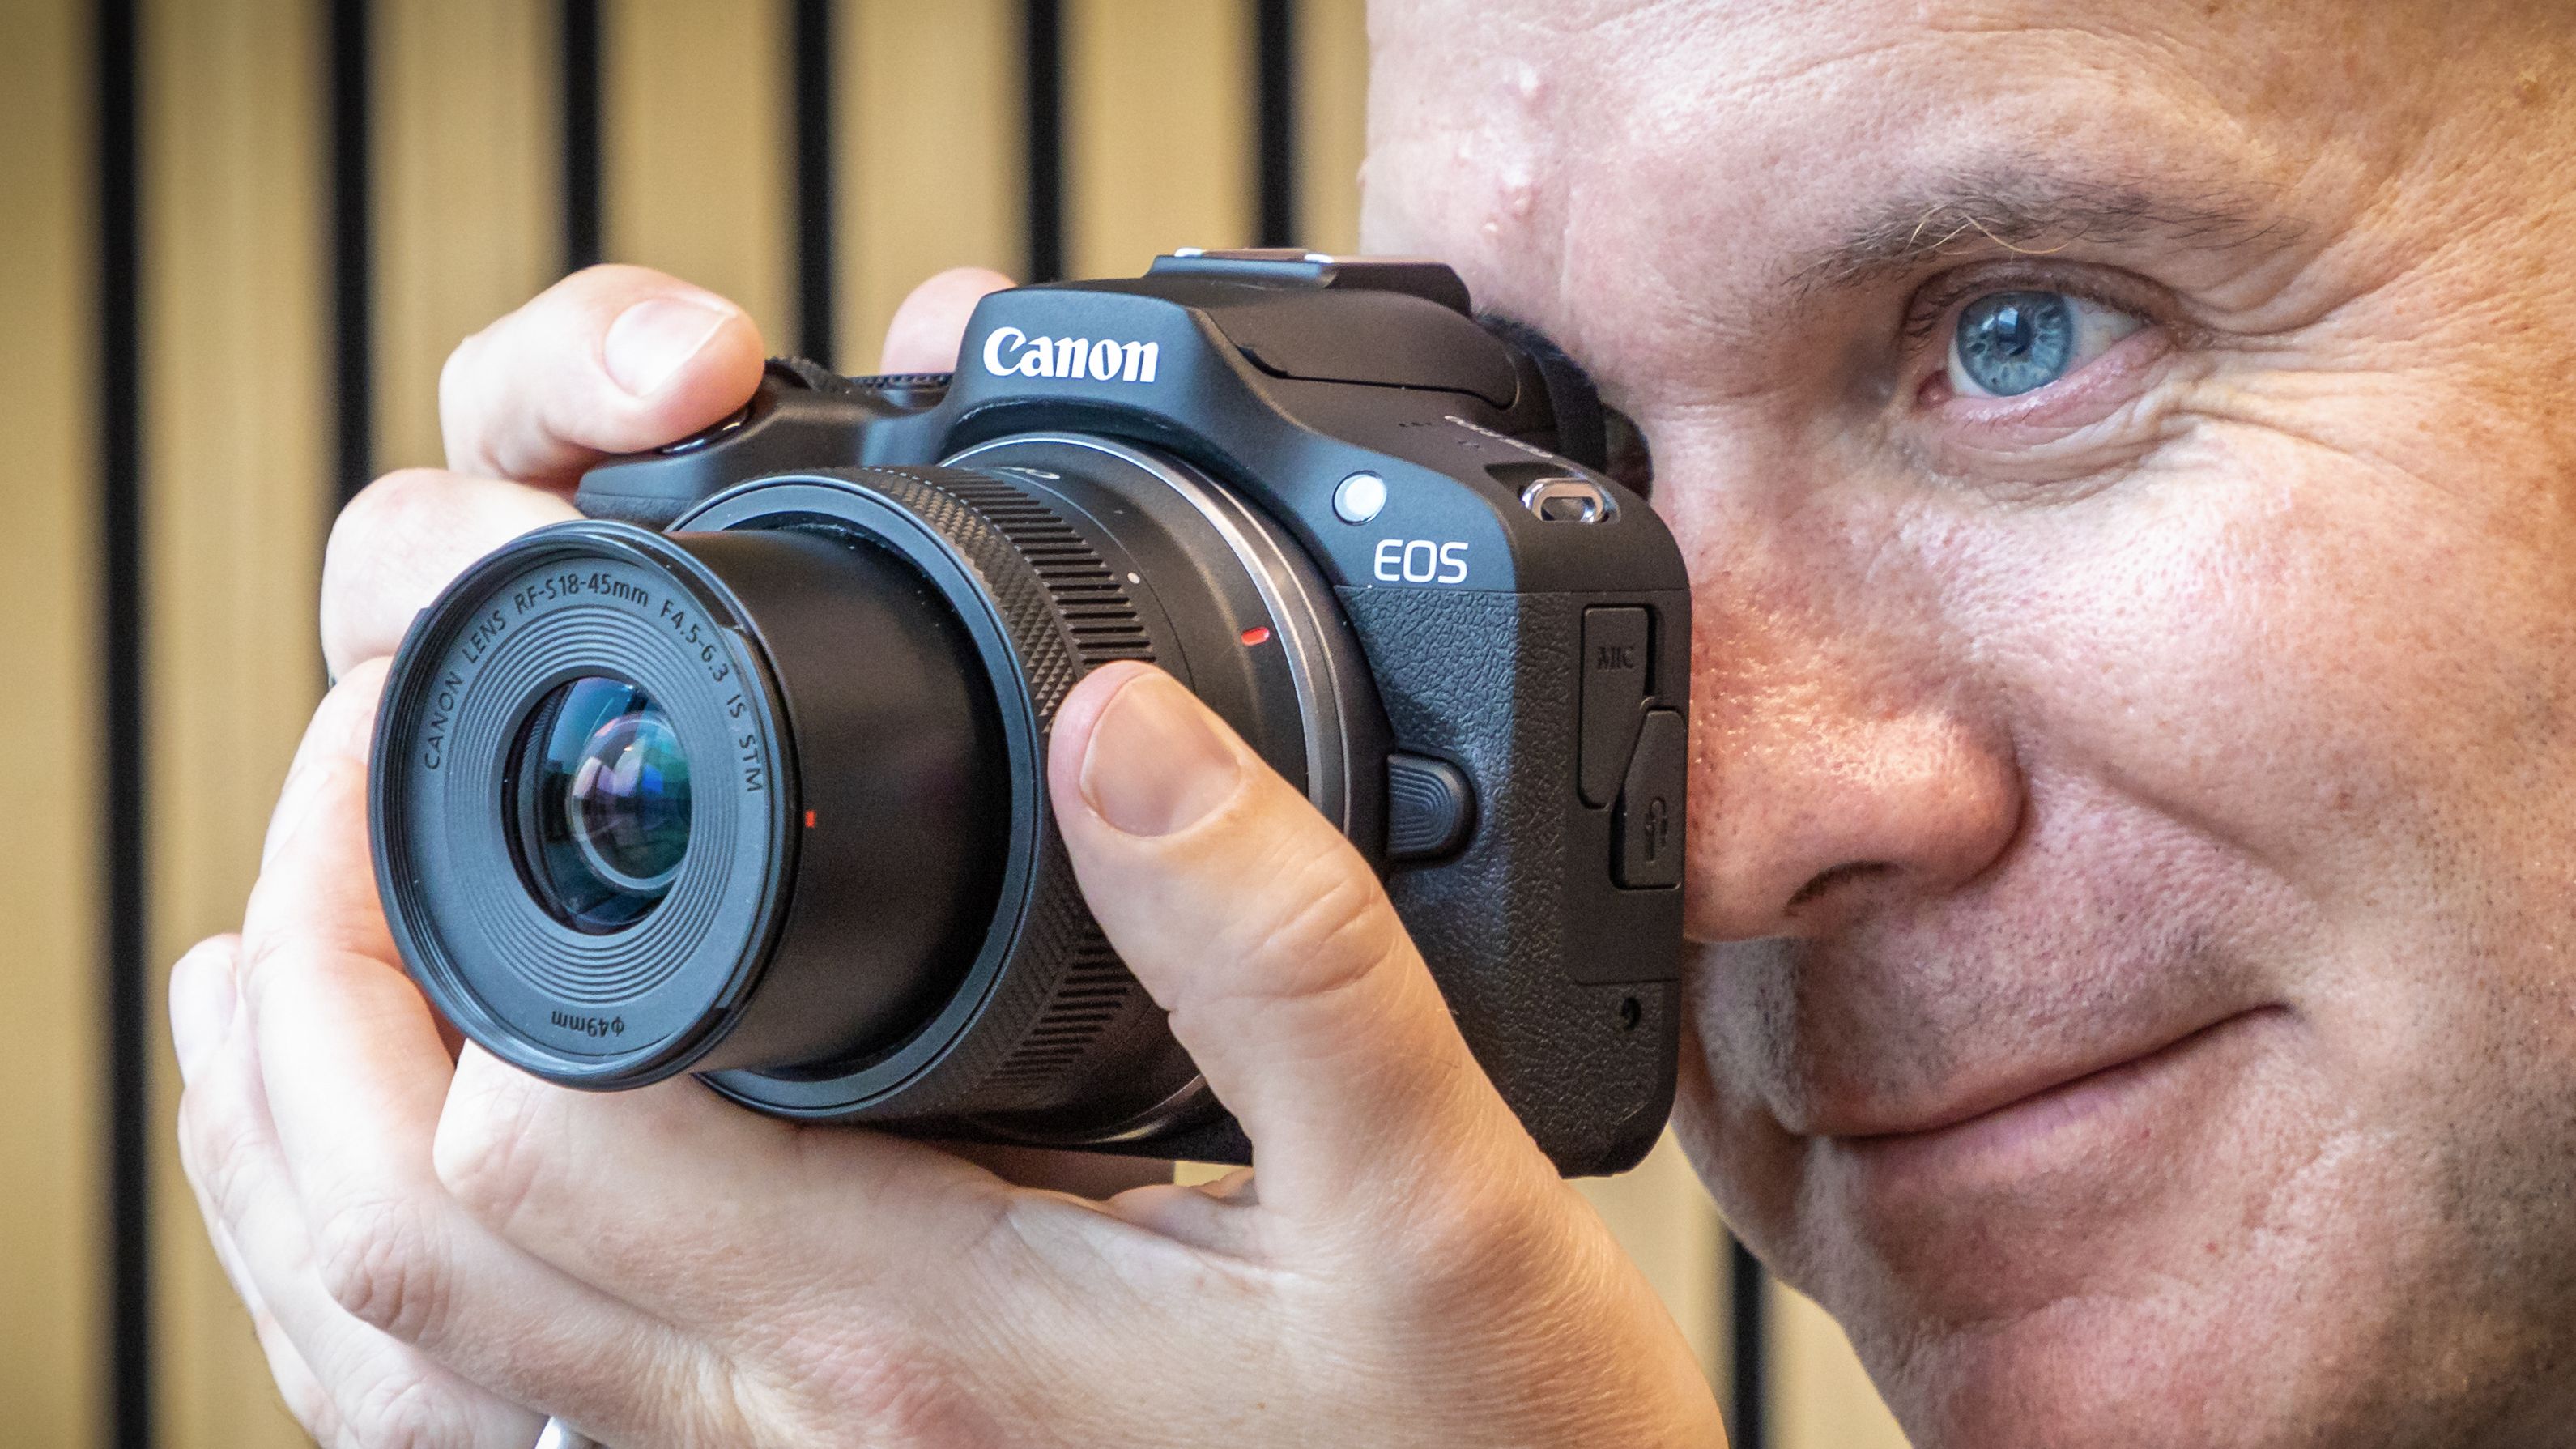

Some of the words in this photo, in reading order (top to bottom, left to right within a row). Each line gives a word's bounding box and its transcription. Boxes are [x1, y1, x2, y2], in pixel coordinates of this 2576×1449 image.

[983, 326, 1159, 382] Canon
[1373, 539, 1469, 584] EOS
[425, 671, 462, 769] CANON
[462, 610, 506, 664] LENS
[513, 573, 648, 614] RF-S18-45mm
[660, 599, 730, 683] F4.5-6.3
[726, 694, 747, 718] IS
[739, 734, 763, 792] STM
